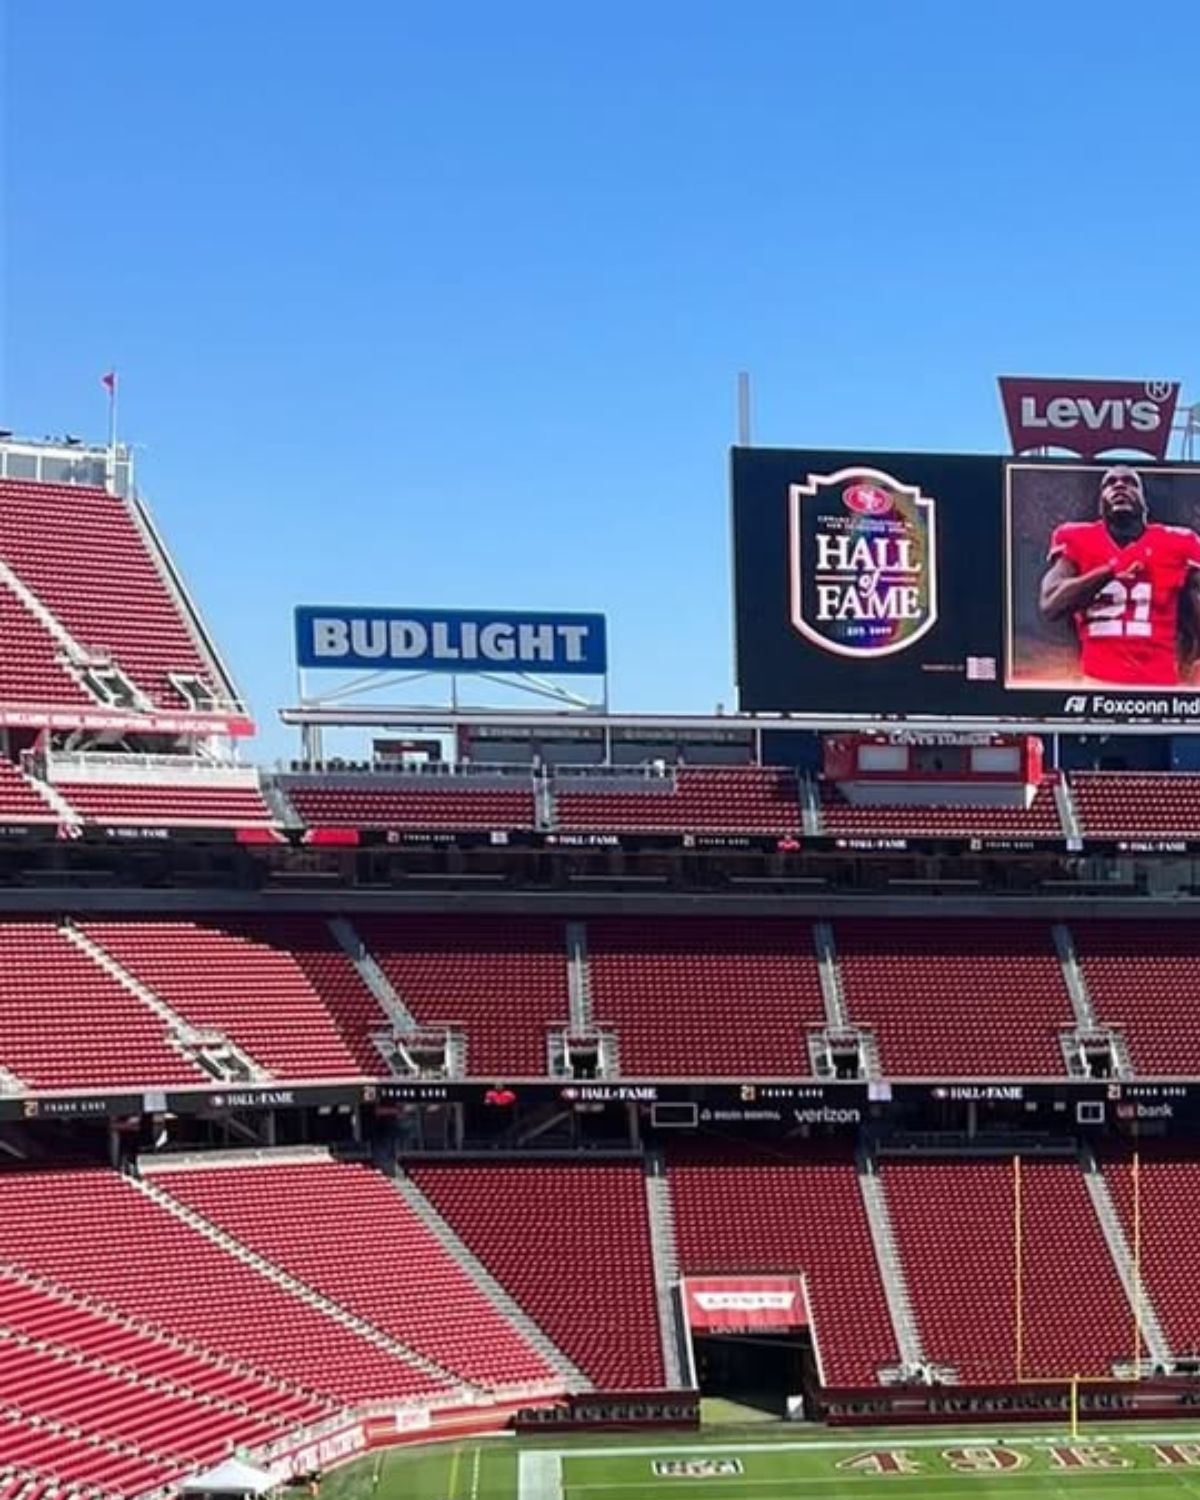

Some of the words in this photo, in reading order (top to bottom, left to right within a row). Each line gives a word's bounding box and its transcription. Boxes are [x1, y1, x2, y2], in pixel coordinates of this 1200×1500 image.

[816, 534, 922, 572] HALL
[859, 568, 881, 598] of
[816, 584, 922, 620] FAME
[1087, 579, 1152, 637] 21
[1092, 697, 1168, 714] Foxconn
[795, 1106, 860, 1122] verizon
[1137, 1103, 1173, 1118] bank
